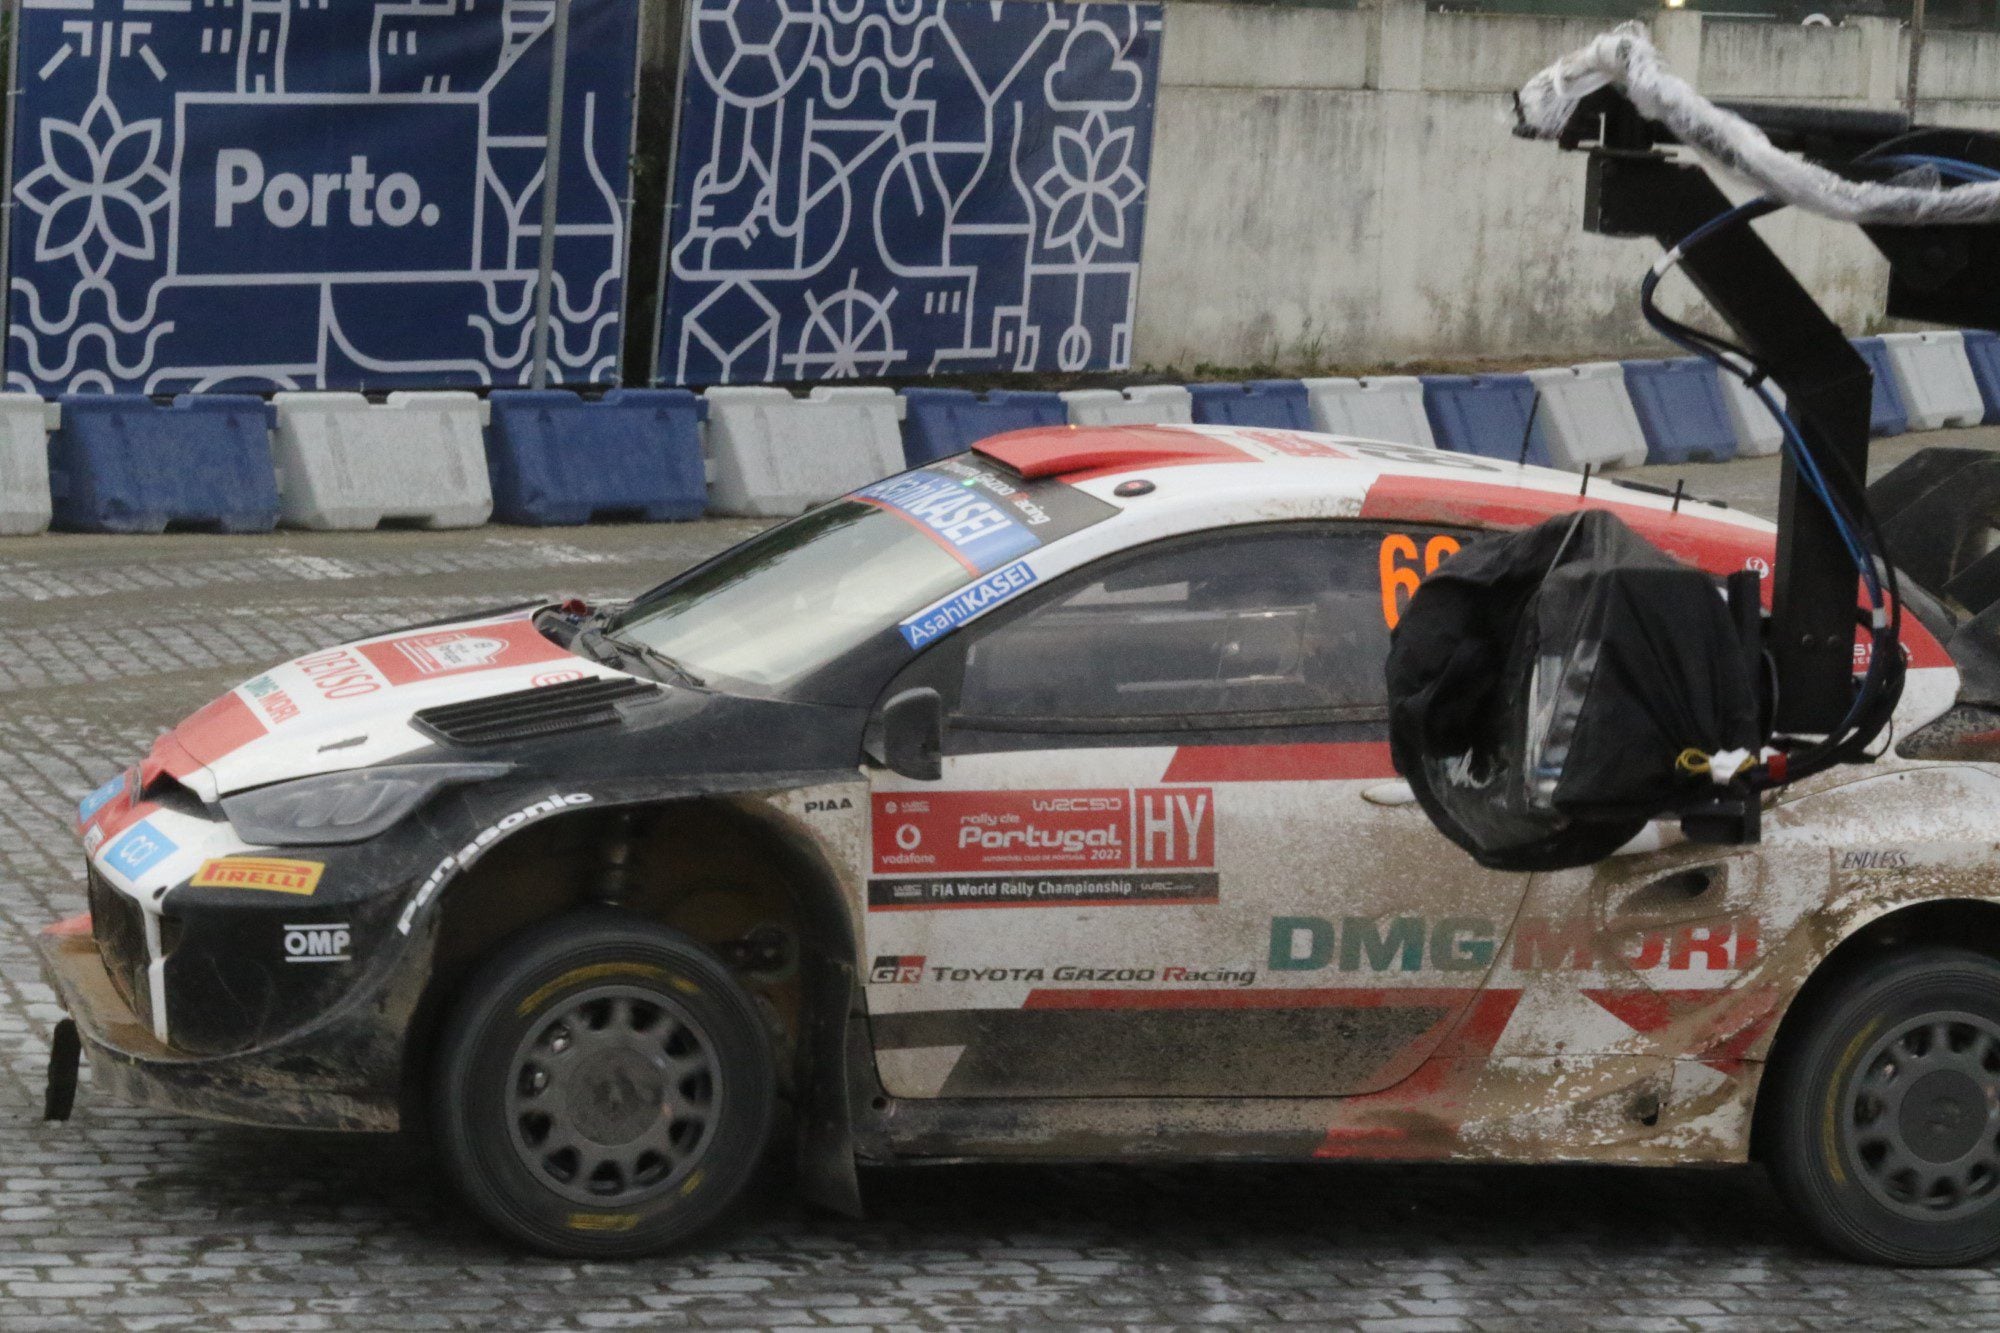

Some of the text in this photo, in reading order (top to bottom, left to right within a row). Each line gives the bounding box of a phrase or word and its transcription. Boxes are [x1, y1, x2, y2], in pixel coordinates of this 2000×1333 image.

[215, 149, 440, 228] Porto.
[909, 564, 1032, 645] AsahiKASEI
[295, 650, 381, 699] DENSO
[804, 798, 853, 813] PIAA
[960, 812, 1020, 826] rally de
[1143, 795, 1208, 861] HY
[958, 824, 1122, 852] Portugal
[397, 793, 594, 936] Panasonic
[882, 853, 936, 864] vodafone
[1090, 849, 1121, 860] 2022
[1841, 851, 1908, 868] ENDLESS
[203, 863, 311, 888] PIRELLI
[932, 884, 953, 896] FIA
[957, 882, 996, 896] World
[1001, 881, 1034, 897] Rally
[1038, 880, 1132, 896] Championship
[284, 930, 350, 955] OMP
[1267, 916, 1496, 971] DMG
[870, 965, 1257, 986] GR TOYOTA GAZOO Racing
